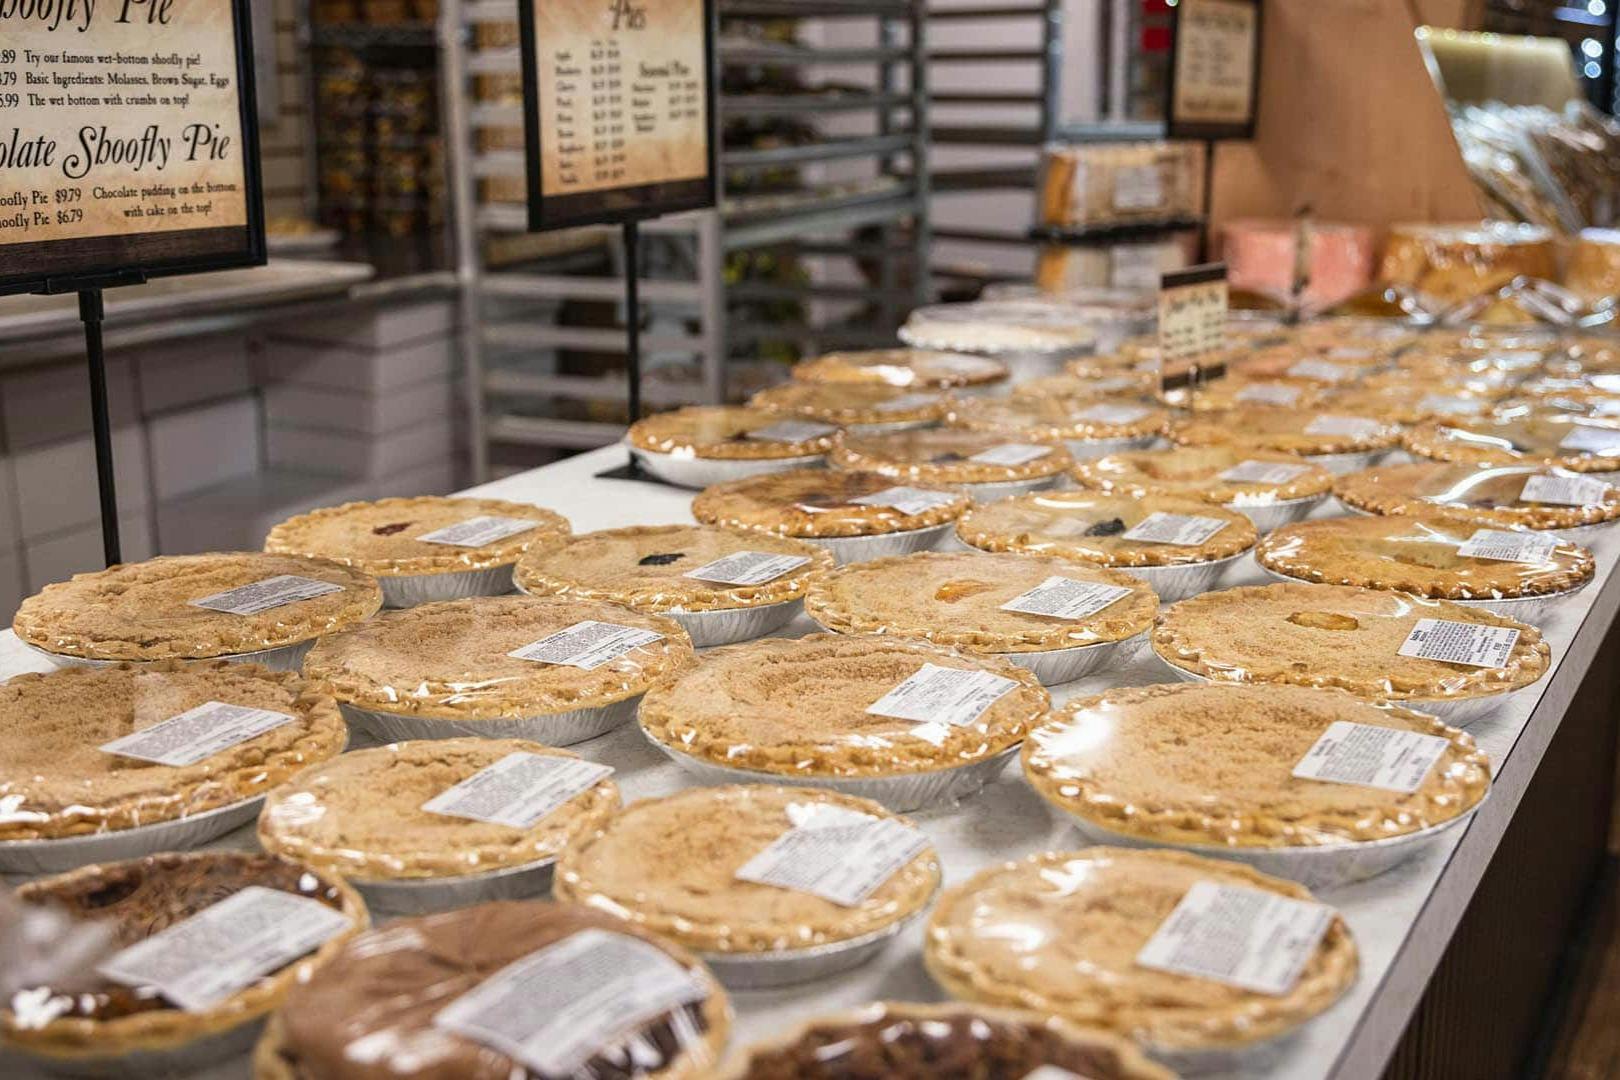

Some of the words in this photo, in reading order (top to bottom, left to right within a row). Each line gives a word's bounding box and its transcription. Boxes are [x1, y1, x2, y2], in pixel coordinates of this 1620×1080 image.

[24, 50, 41, 69] Try
[44, 53, 59, 64] our
[62, 51, 94, 64] famous
[97, 53, 149, 65] wet-bottom
[153, 53, 183, 68] shoofly
[26, 72, 49, 85] Basic
[152, 73, 179, 85] Brown
[27, 94, 46, 106] The
[49, 96, 64, 106] wet
[68, 94, 100, 106] bottom
[104, 94, 123, 105] with
[126, 94, 157, 105] crumbs
[63, 126, 171, 179] Shoofly
[182, 124, 230, 161] Pie
[32, 190, 48, 205] Pie
[92, 186, 139, 200] Chocolate
[142, 184, 175, 200] pudding
[179, 187, 189, 195] on
[191, 182, 205, 193] the
[207, 181, 236, 193] bottom
[124, 204, 144, 217] with
[146, 203, 165, 216] cake
[168, 207, 178, 216] on
[182, 202, 194, 214] the
[34, 212, 50, 226] Pie
